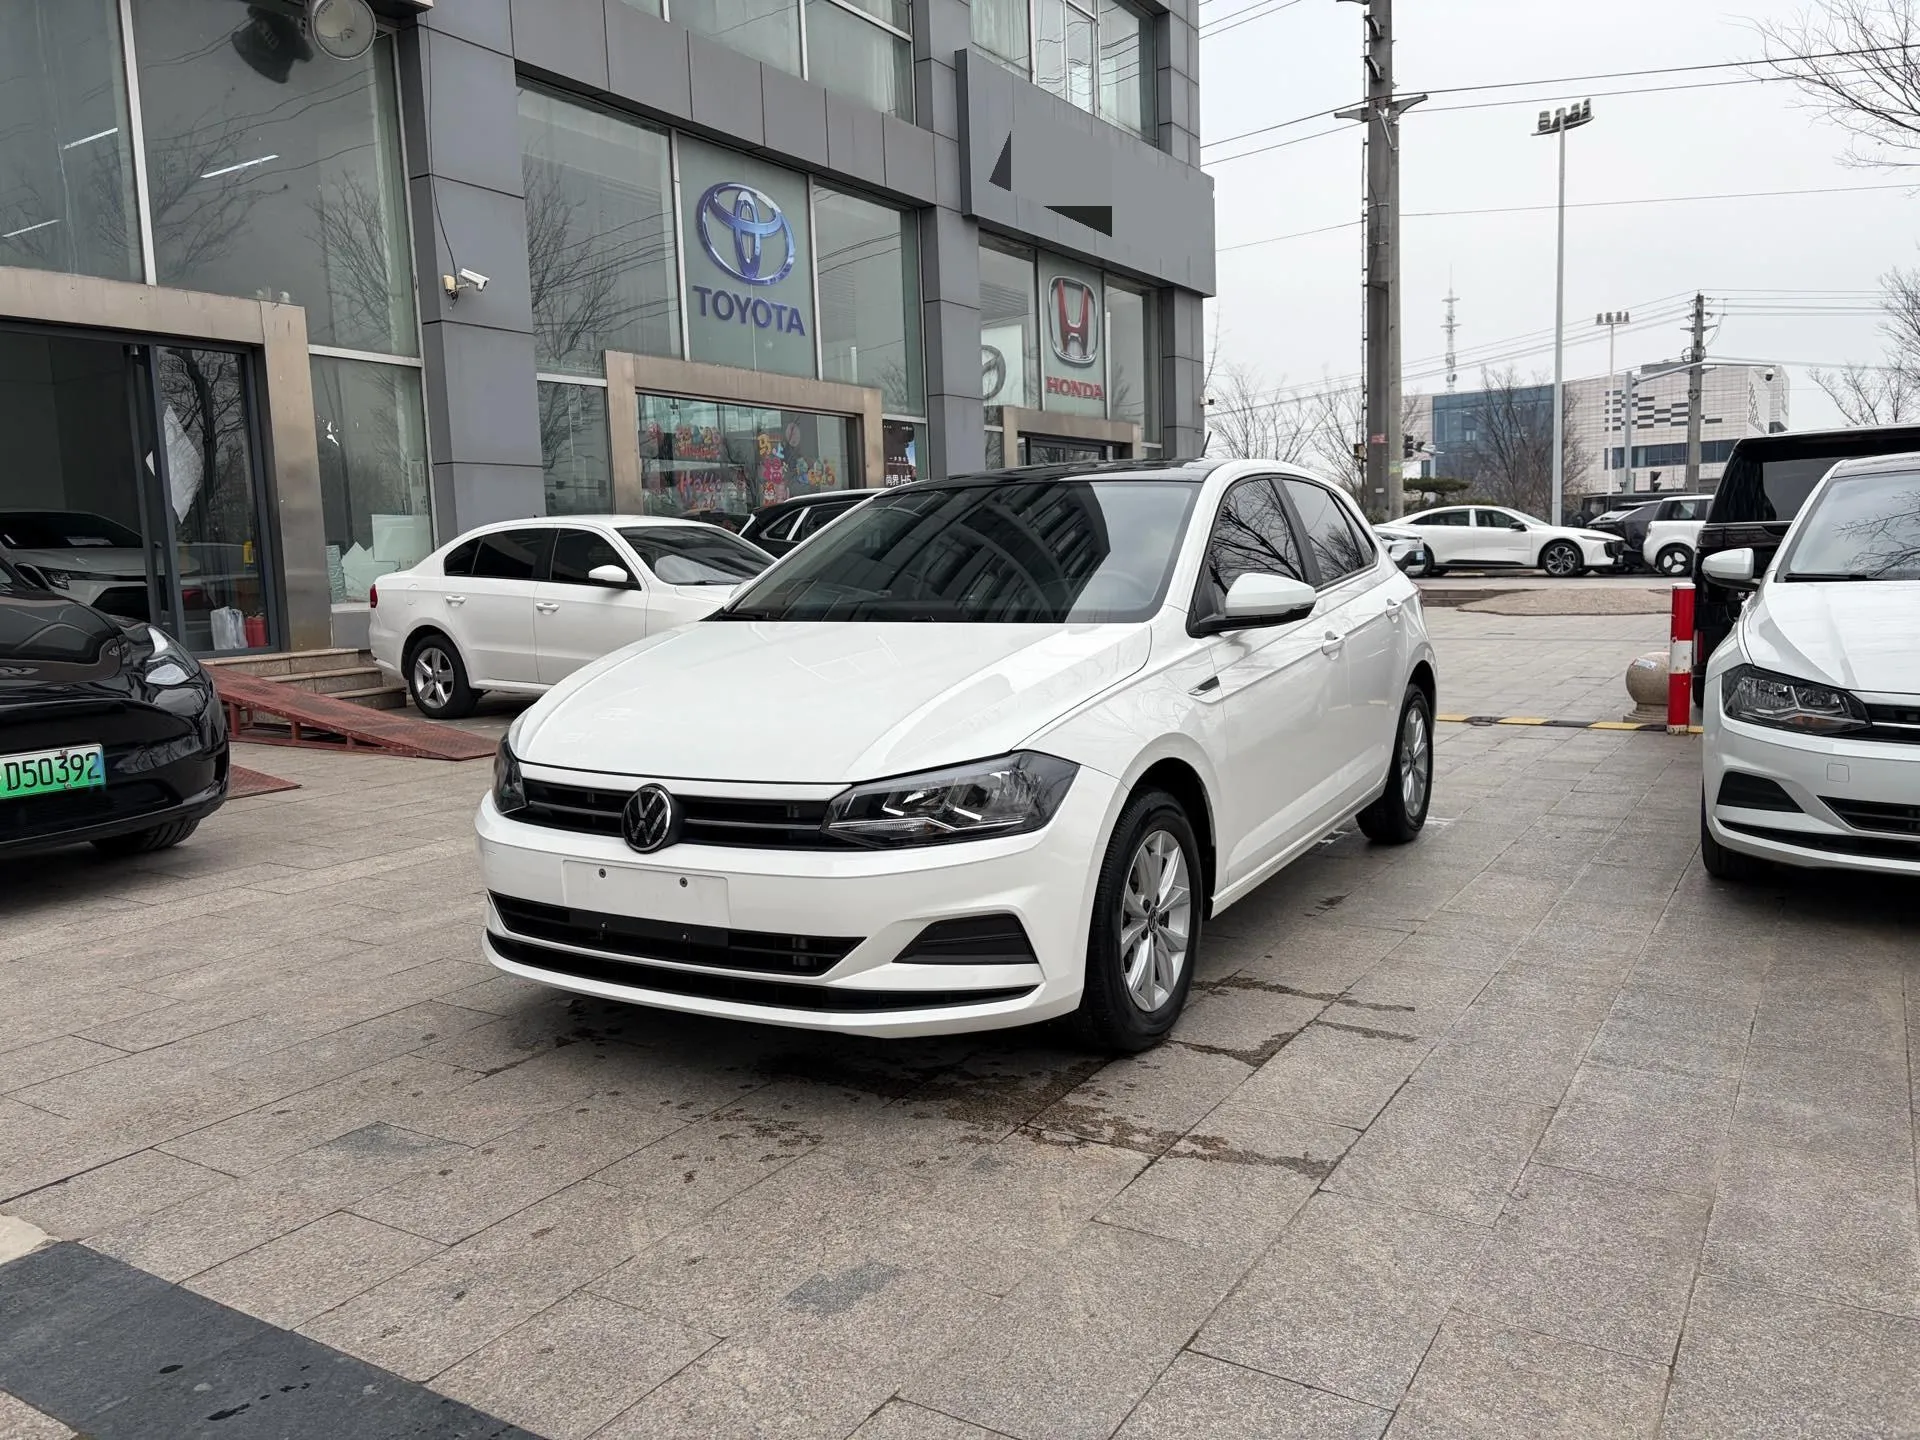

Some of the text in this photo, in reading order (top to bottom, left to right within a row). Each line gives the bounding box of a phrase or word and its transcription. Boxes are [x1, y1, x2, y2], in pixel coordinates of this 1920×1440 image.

[691, 285, 806, 337] TOYOTA
[1046, 376, 1105, 400] HONDA
[900, 474, 912, 485] H5
[4, 751, 101, 792] D50392
